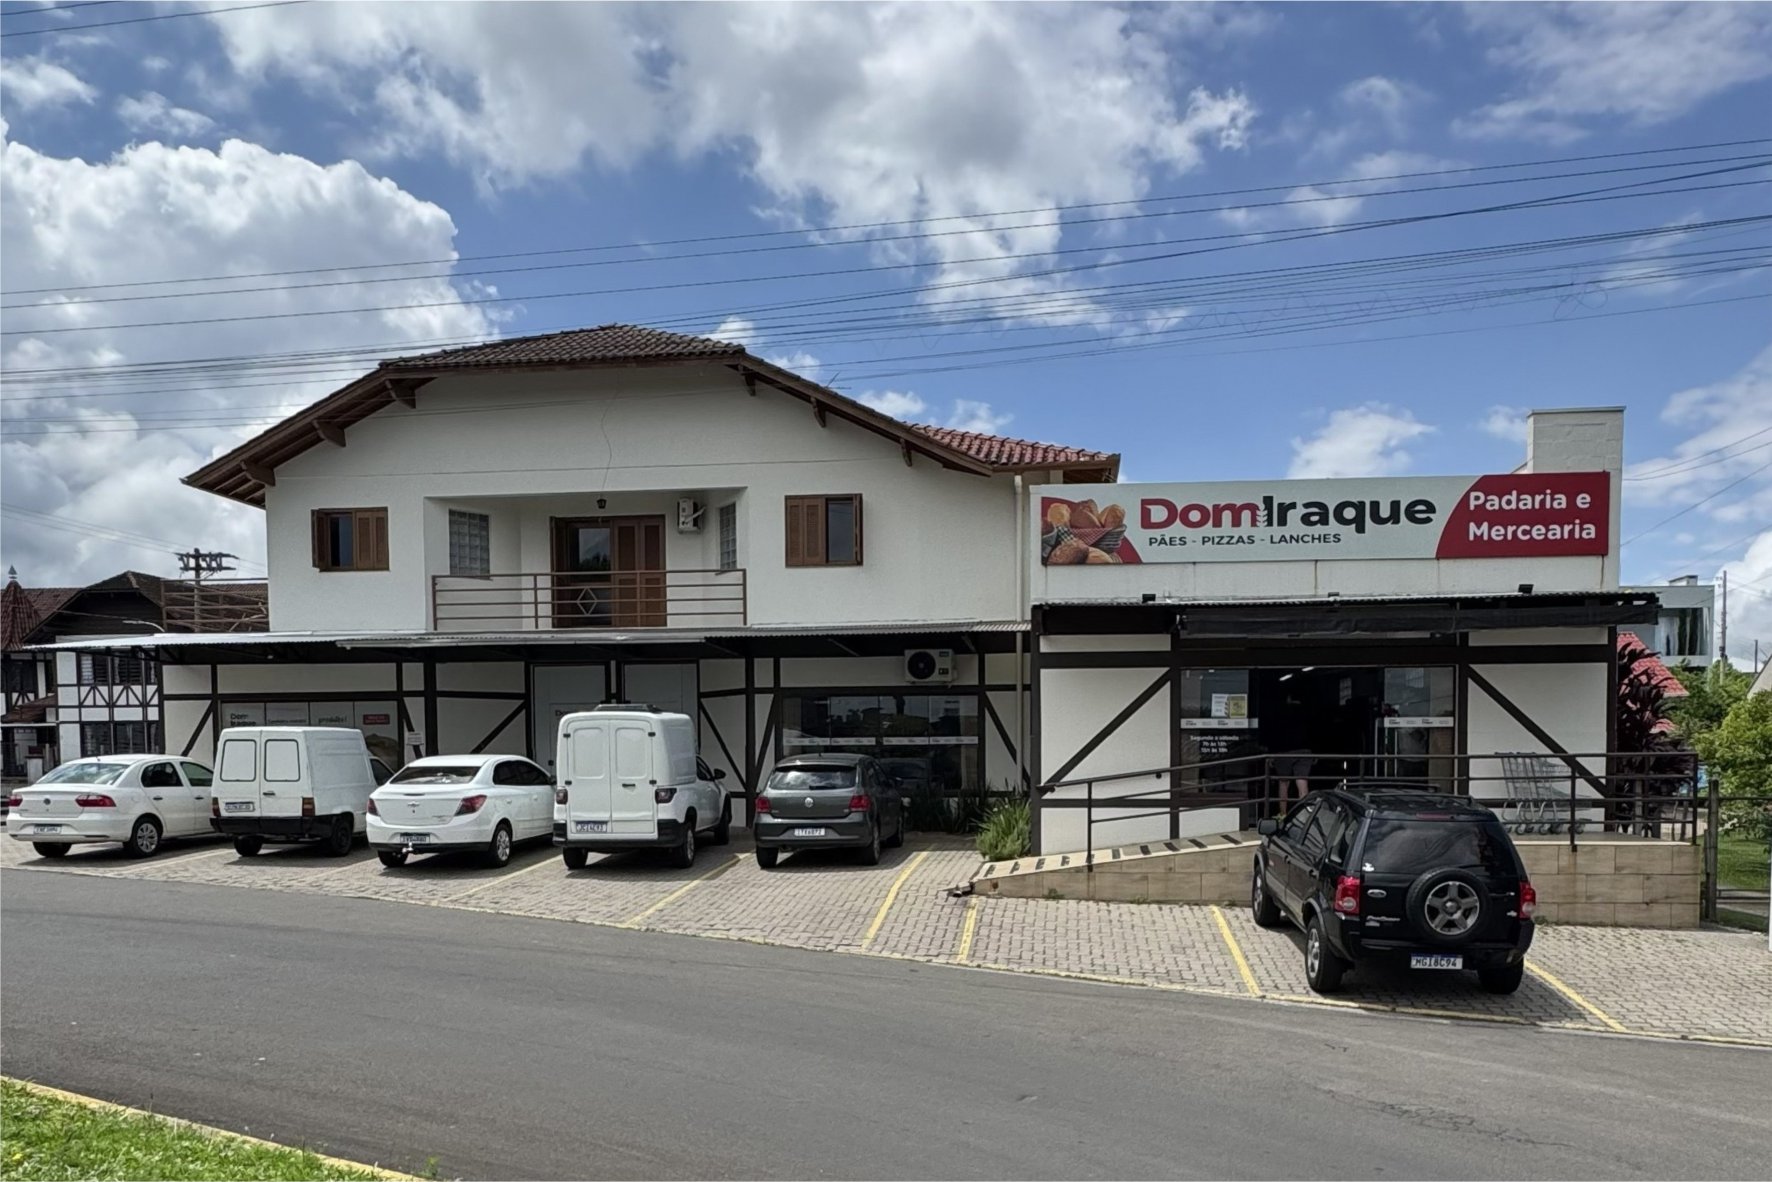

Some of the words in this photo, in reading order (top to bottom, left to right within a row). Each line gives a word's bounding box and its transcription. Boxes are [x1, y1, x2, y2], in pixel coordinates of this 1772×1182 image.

[1469, 489, 1567, 511] Padaria
[1576, 493, 1592, 509] e
[1149, 534, 1188, 547] PÃES
[1202, 535, 1255, 546] PIZZAS
[1270, 533, 1342, 545] LANCHES
[1468, 519, 1596, 541] Mercearia
